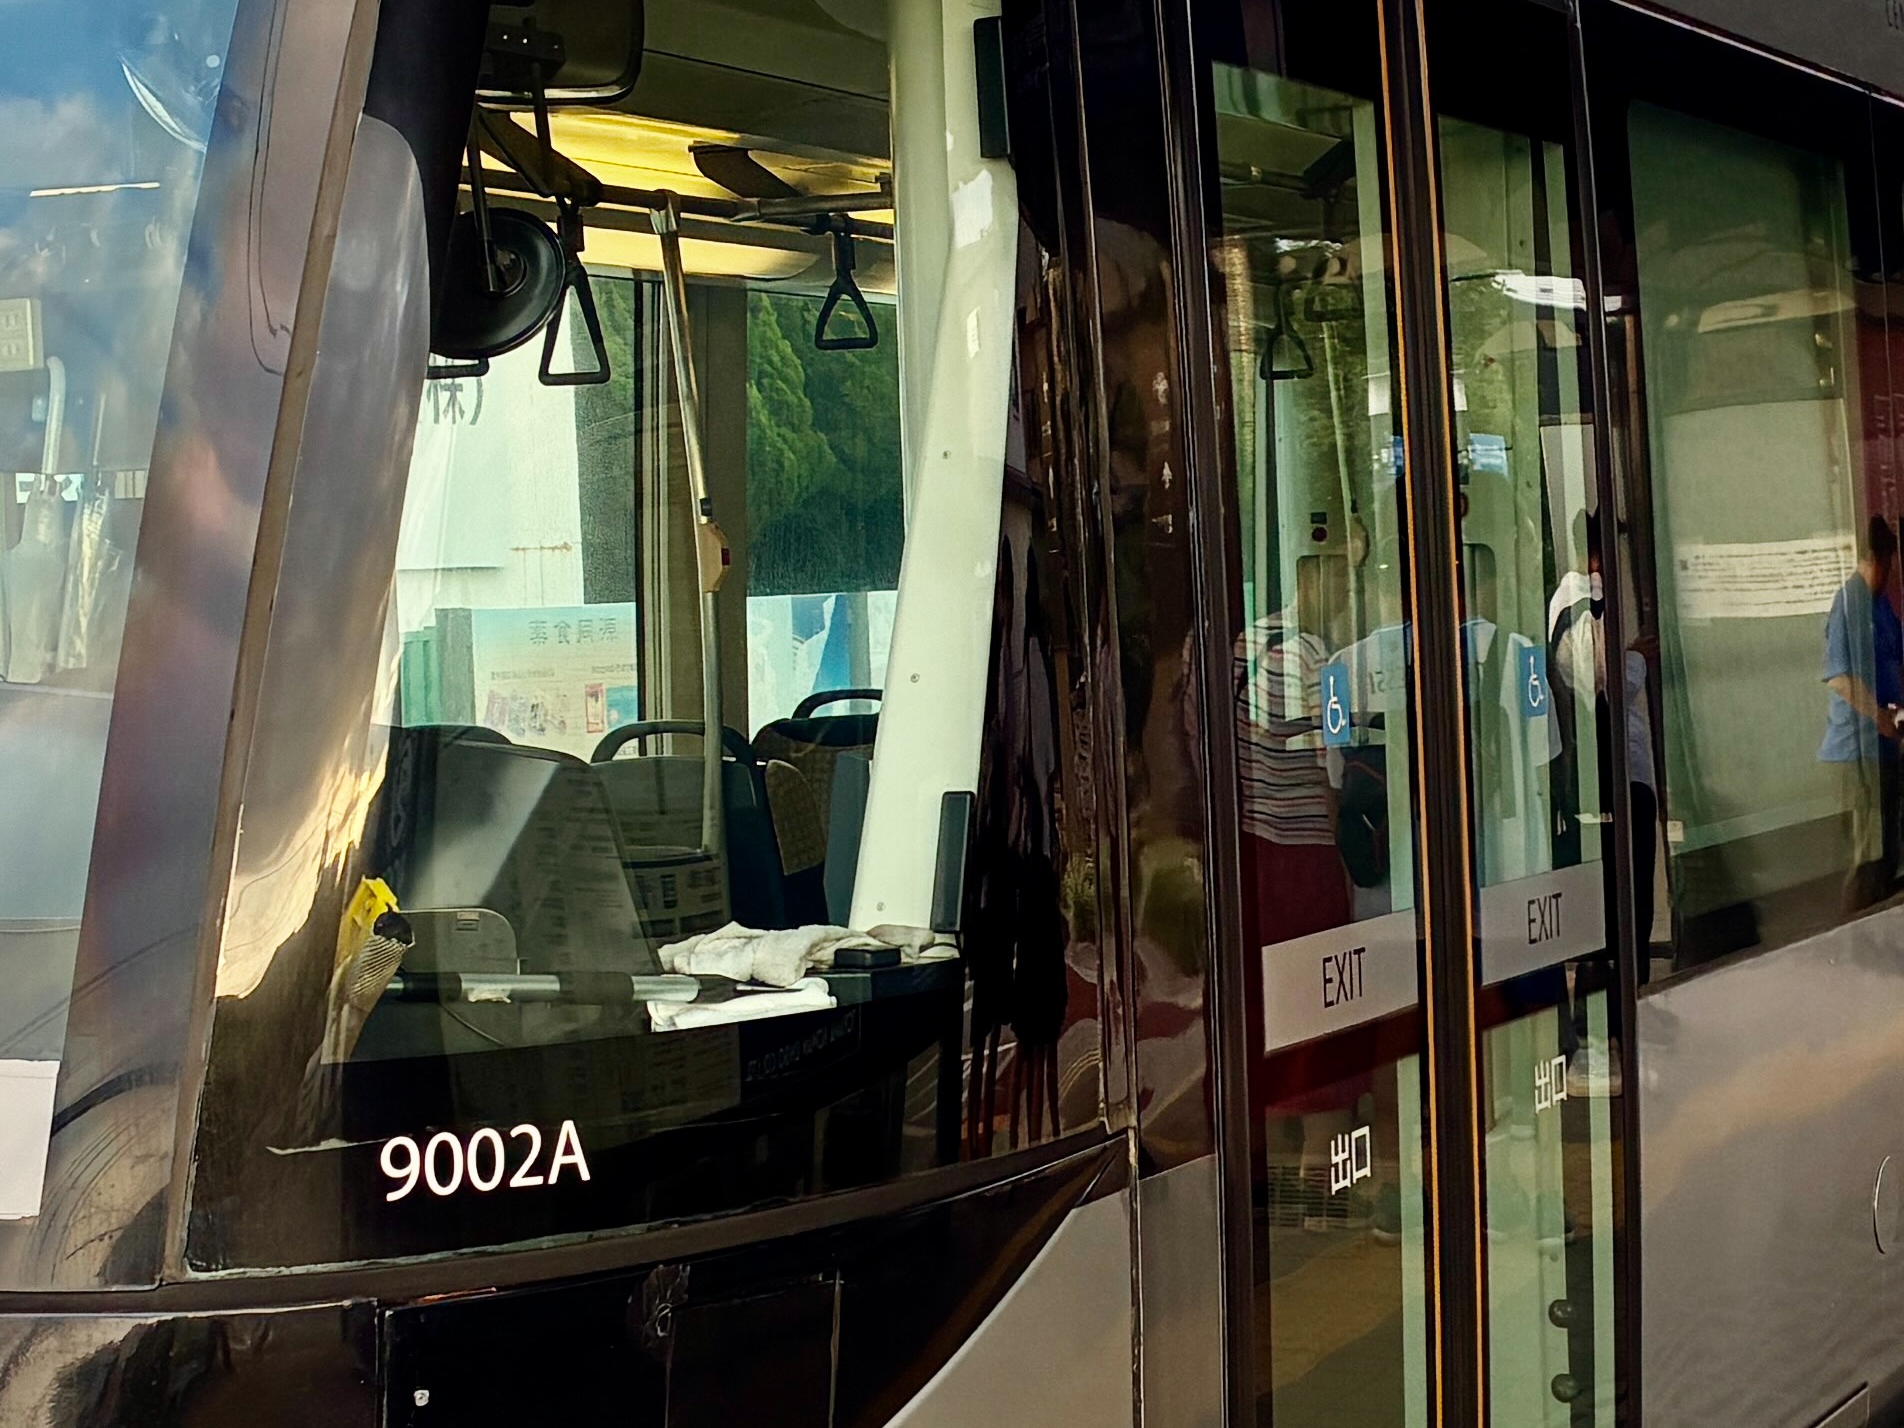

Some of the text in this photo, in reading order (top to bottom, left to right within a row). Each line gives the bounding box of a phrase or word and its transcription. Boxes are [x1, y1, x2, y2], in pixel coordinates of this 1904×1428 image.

[1527, 891, 1563, 947] EXIT
[1322, 946, 1367, 1009] EXIT
[1534, 1054, 1567, 1114] 出口
[379, 1119, 591, 1202] 9002A
[1330, 1124, 1372, 1196] 出口
